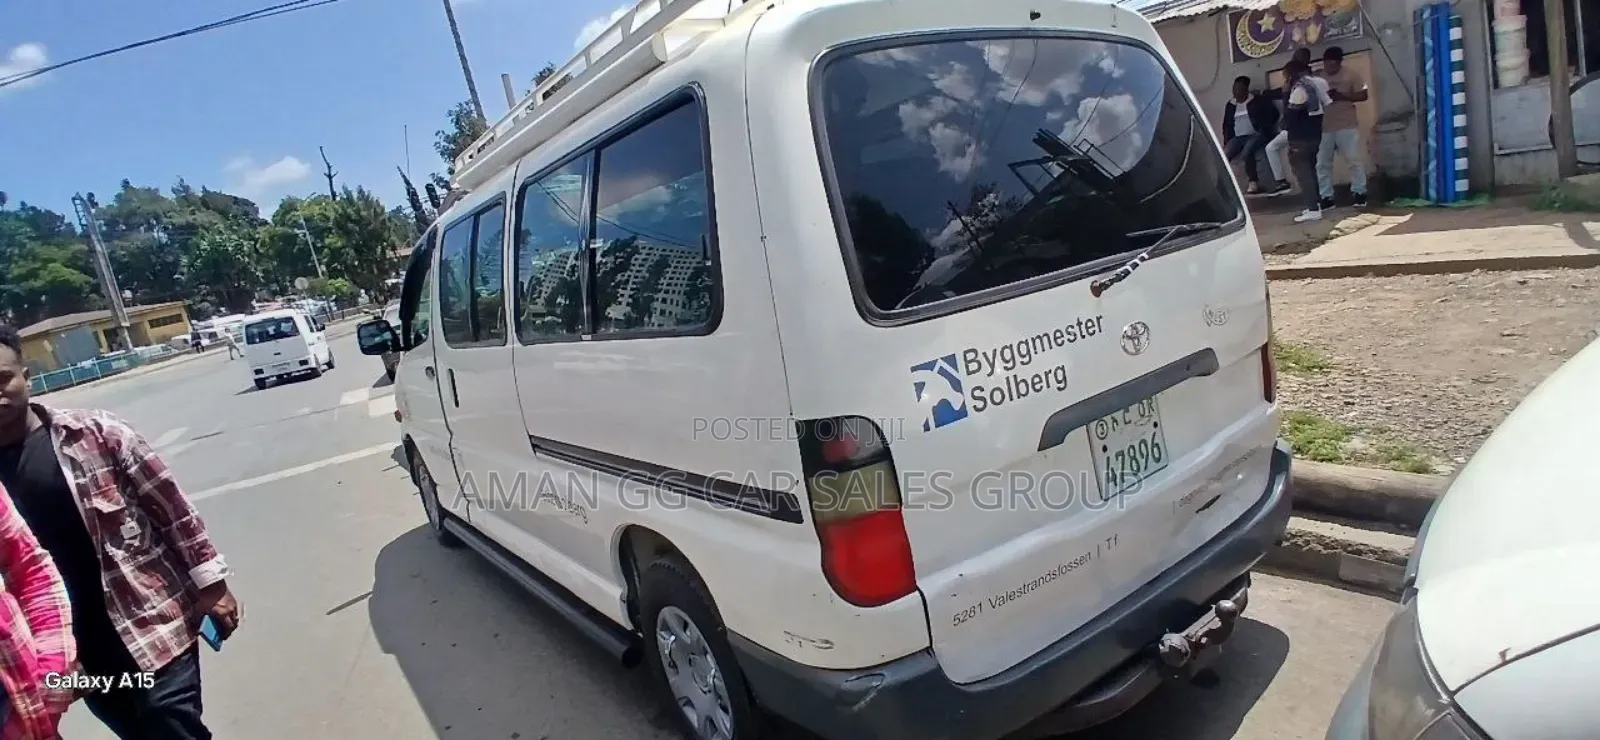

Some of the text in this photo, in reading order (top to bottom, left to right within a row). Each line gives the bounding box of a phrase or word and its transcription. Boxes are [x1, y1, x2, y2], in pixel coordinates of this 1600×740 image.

[963, 314, 1104, 378] Byggmester
[970, 364, 1068, 413] Solberg
[1105, 431, 1162, 487] 47896
[952, 603, 983, 627] 5281
[988, 551, 1091, 609] Valestrandsfossen
